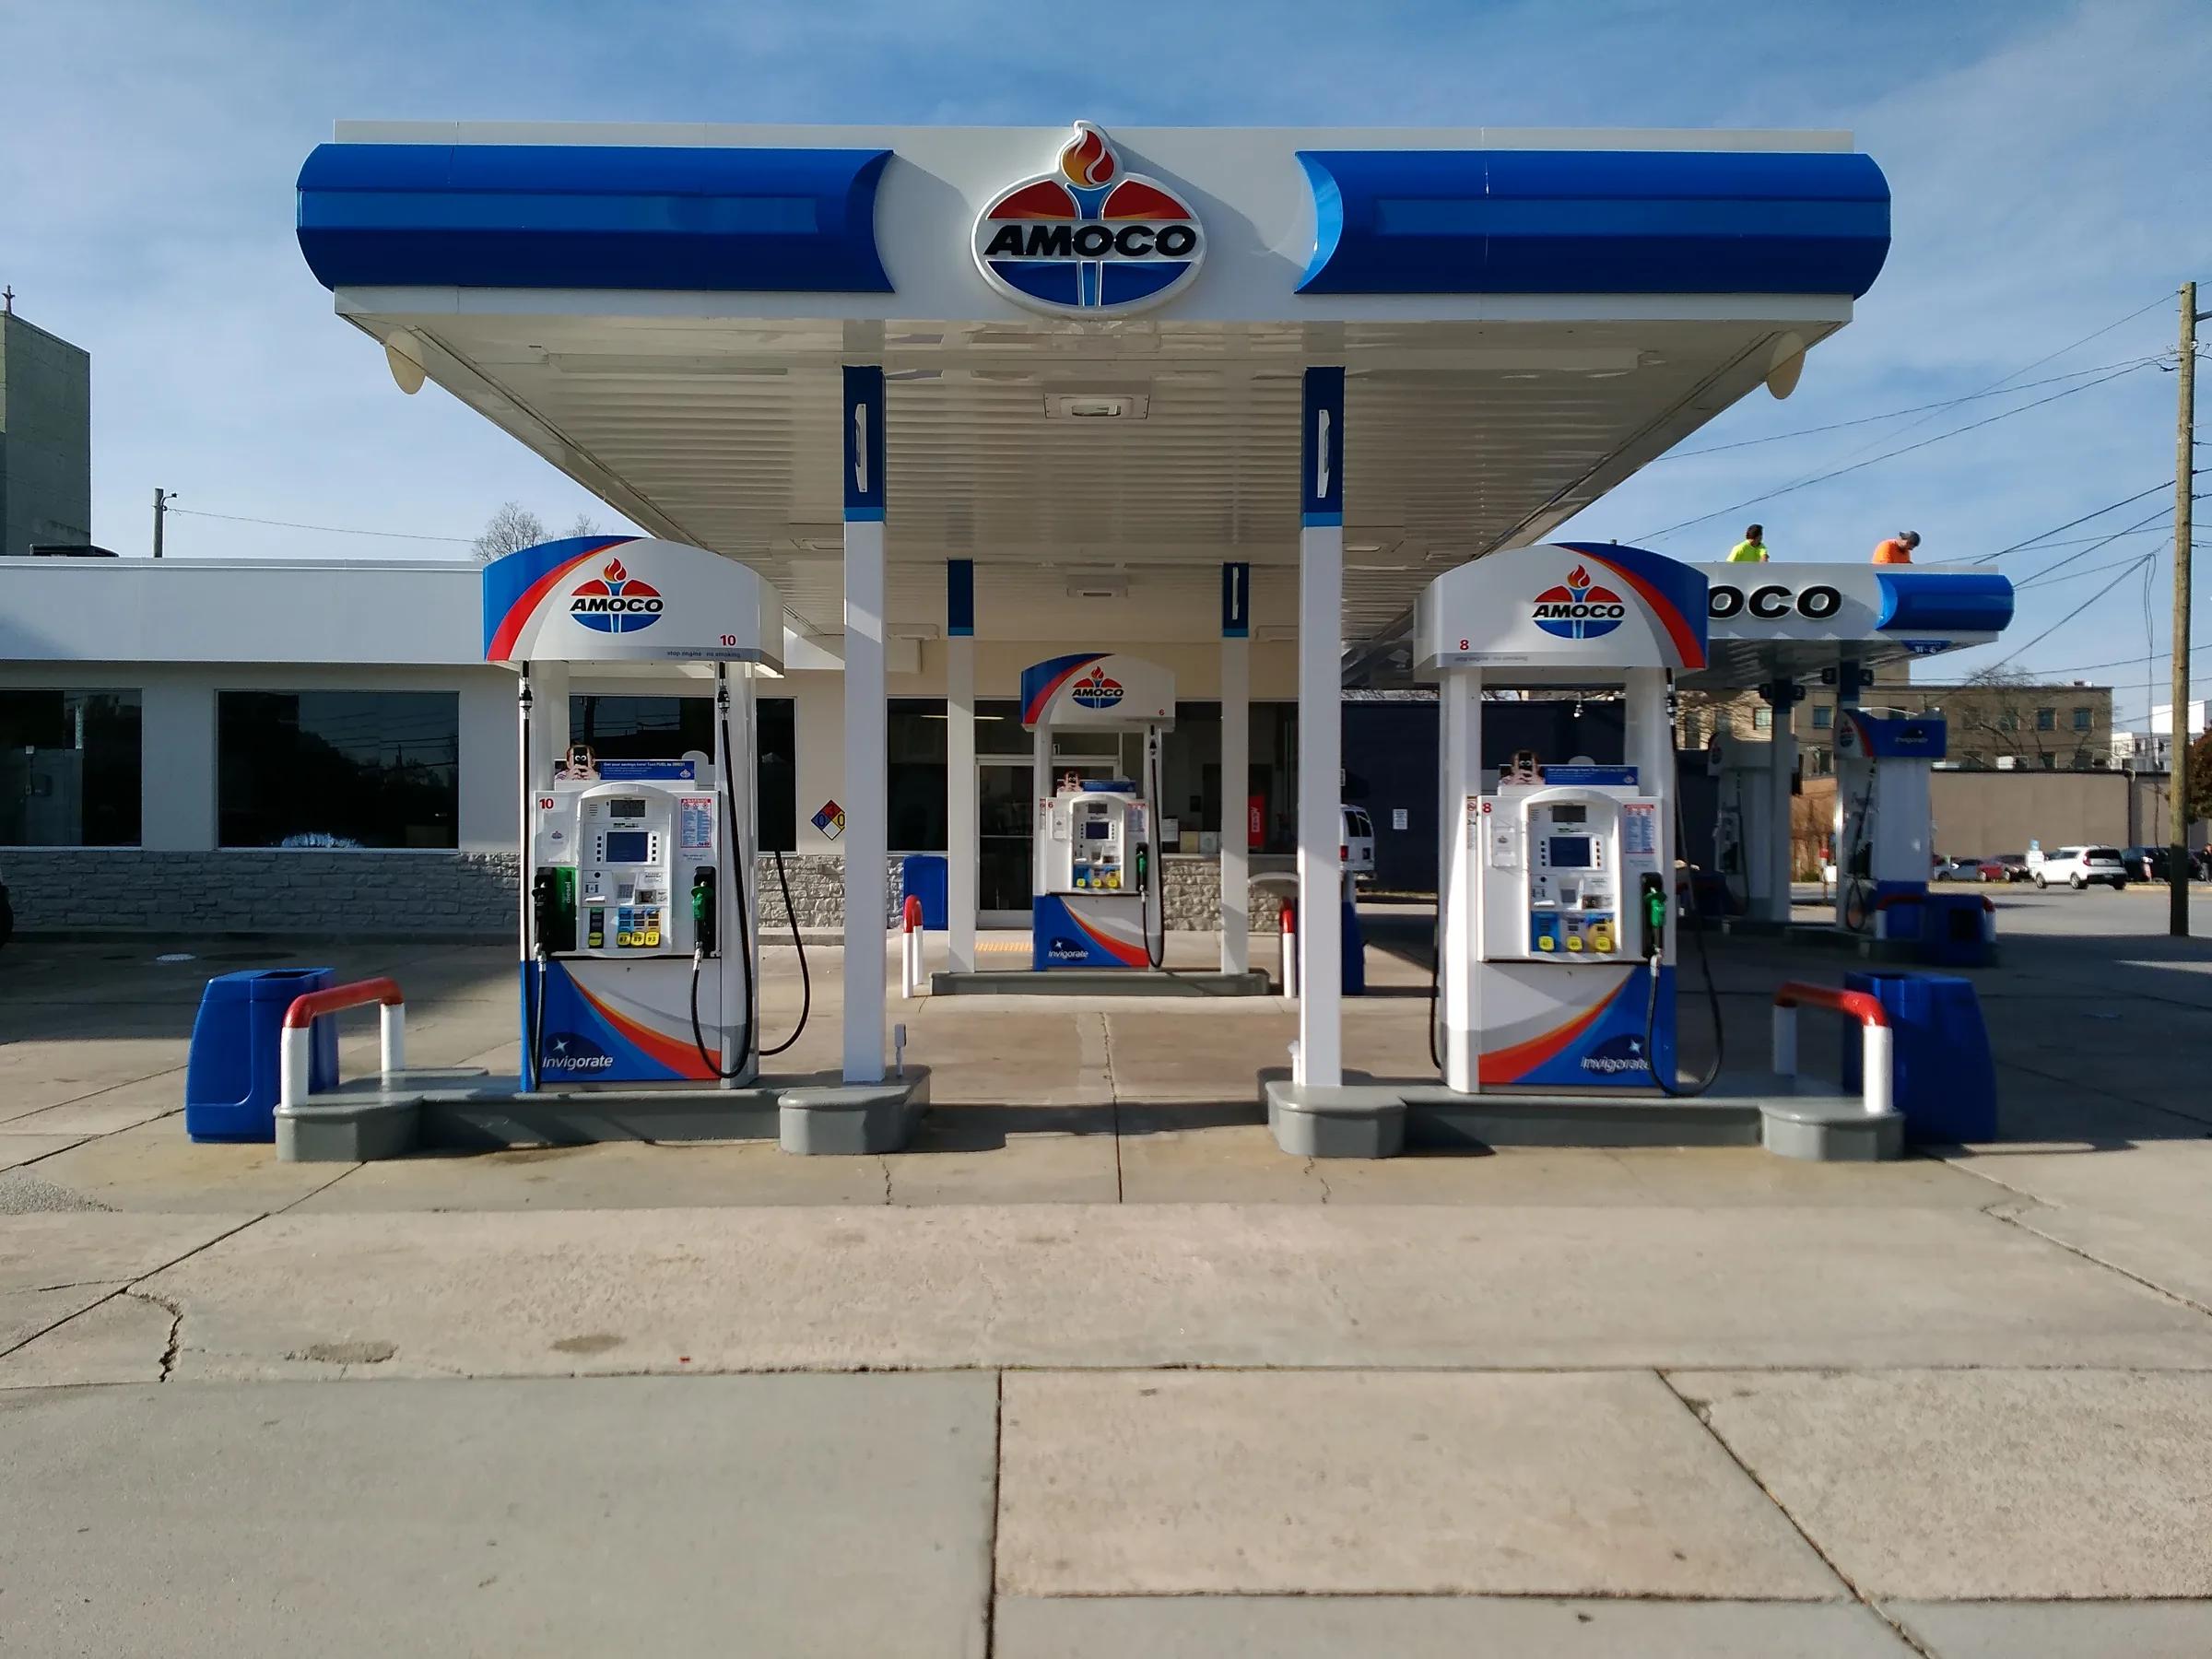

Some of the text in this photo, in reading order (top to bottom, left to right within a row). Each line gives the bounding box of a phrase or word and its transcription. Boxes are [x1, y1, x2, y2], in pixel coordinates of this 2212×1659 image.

[983, 224, 1197, 257] AMOCO
[570, 598, 664, 612] AMOCO
[1708, 584, 1842, 618] OCO
[1532, 604, 1625, 618] AMOCO
[720, 634, 736, 646] 10
[1459, 639, 1469, 651] 8
[1072, 688, 1124, 697] AMOCO
[539, 798, 554, 809] 10
[1482, 802, 1492, 813] 8
[818, 813, 845, 827] 0 0
[1048, 949, 1088, 959] Invigorate
[542, 1054, 613, 1070] Invigorate
